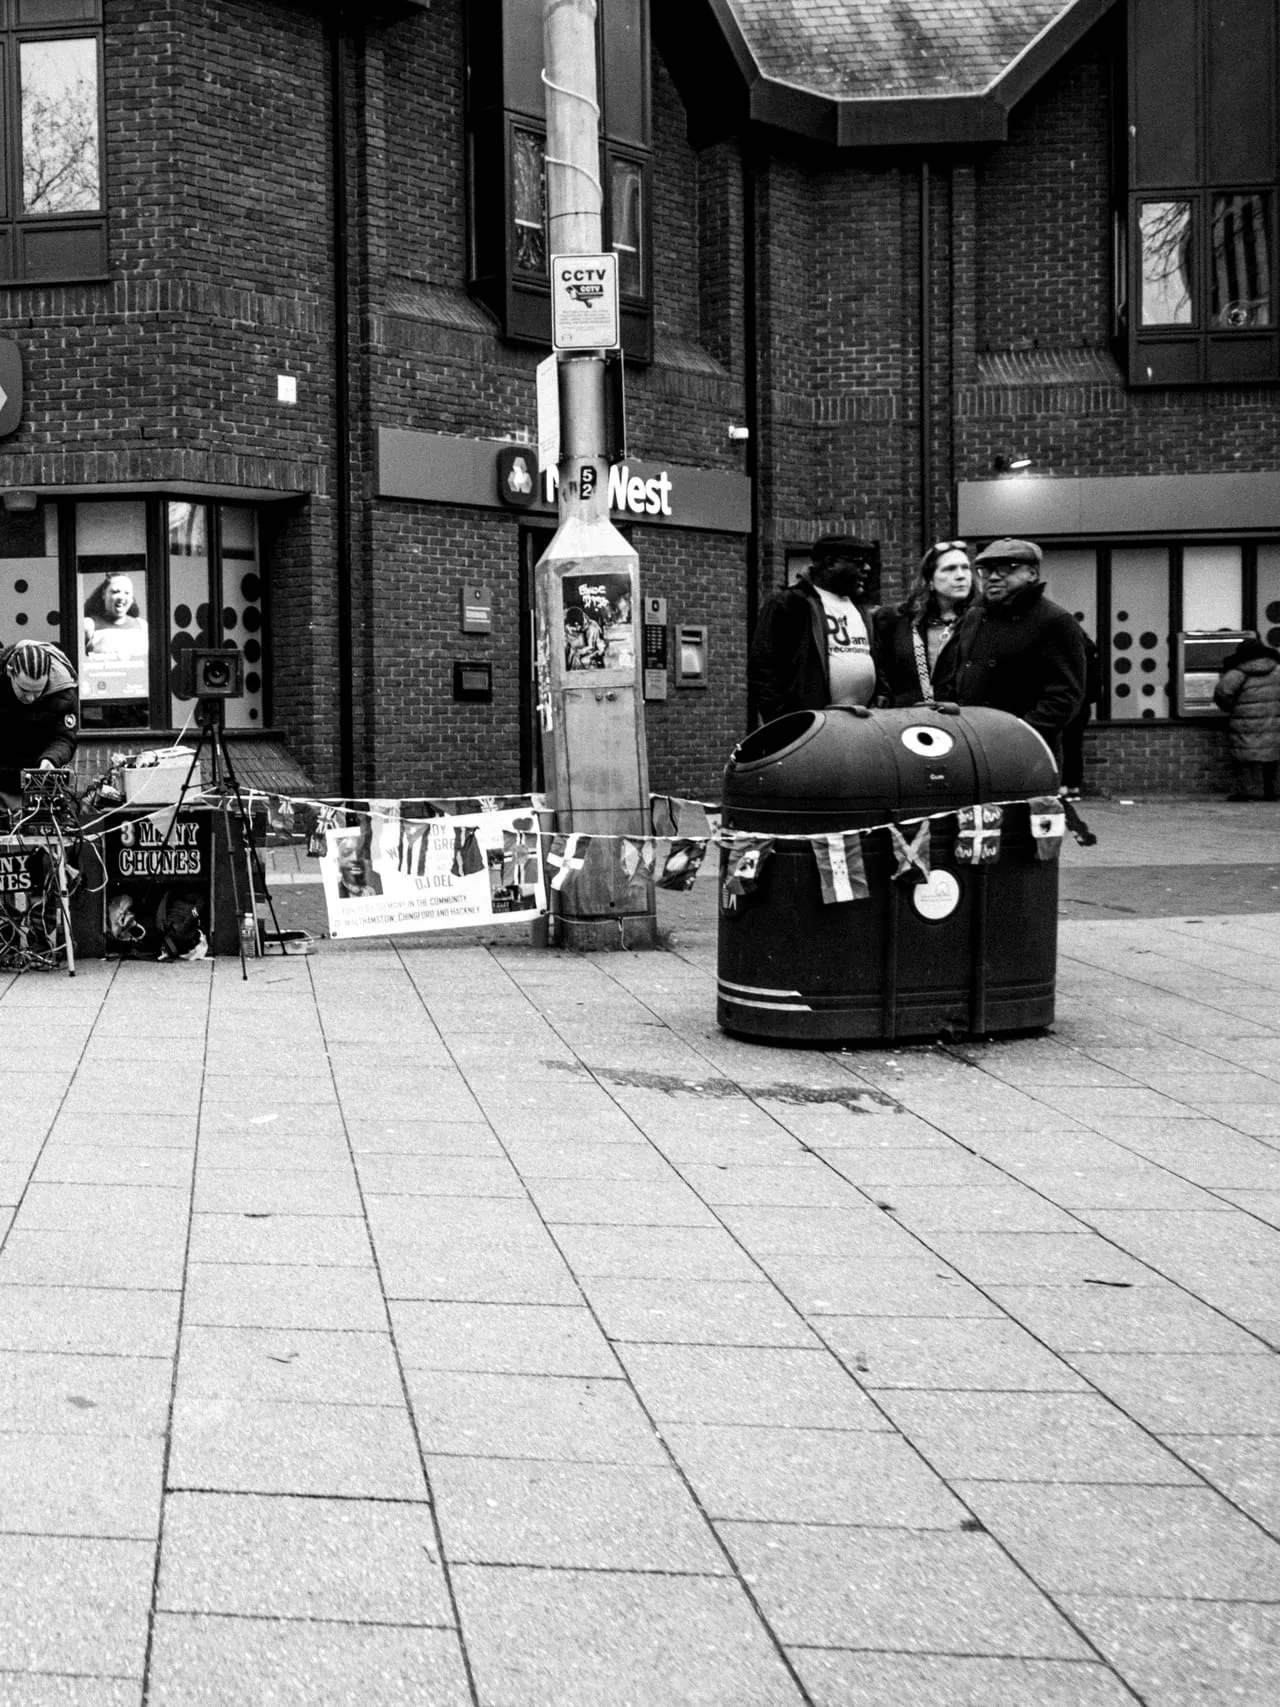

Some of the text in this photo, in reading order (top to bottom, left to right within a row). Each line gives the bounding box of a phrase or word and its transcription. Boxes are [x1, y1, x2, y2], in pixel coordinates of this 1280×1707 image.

[561, 269, 606, 282] CCTV
[546, 463, 673, 516] NWest
[929, 773, 945, 781] Gum
[120, 820, 200, 847] 3 MNY
[118, 848, 201, 876] CHUNES
[407, 899, 415, 908] IN
[416, 898, 427, 907] THE
[429, 894, 467, 906] COMMUNITY
[398, 910, 434, 922] CHINGFORD
[436, 908, 449, 917] AND
[450, 905, 480, 916] HACKNEY
